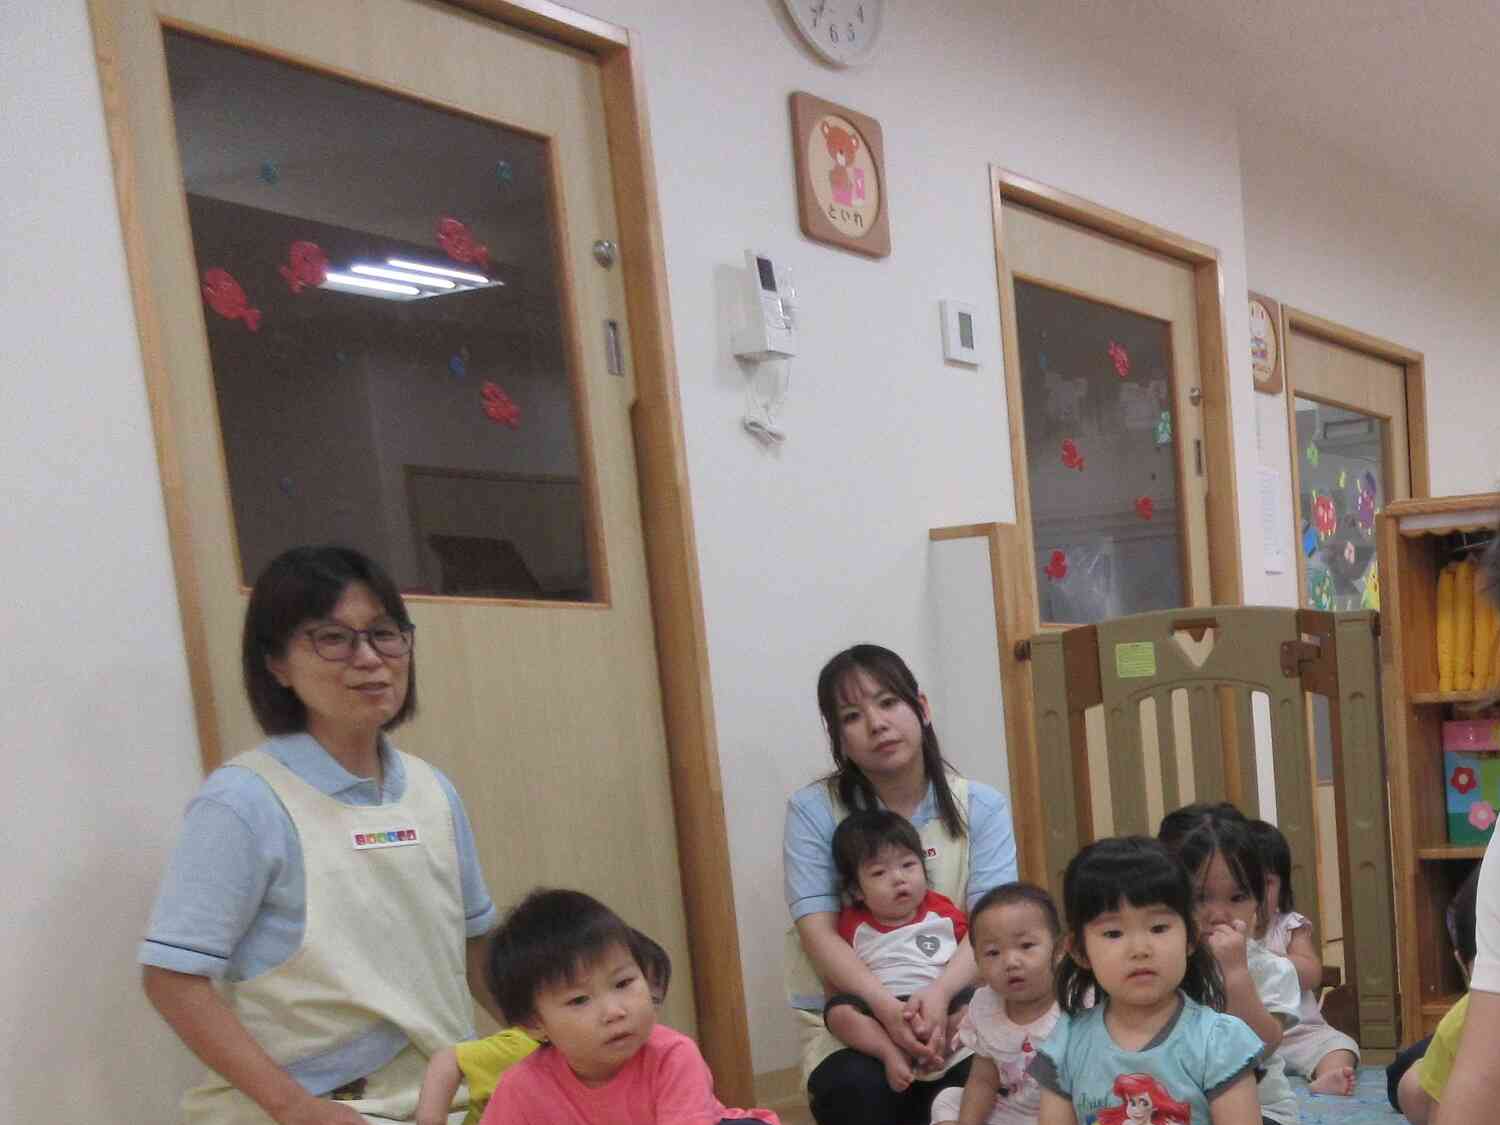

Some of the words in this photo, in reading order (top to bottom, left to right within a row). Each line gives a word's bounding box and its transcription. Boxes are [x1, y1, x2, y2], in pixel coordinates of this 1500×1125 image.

[829, 23, 840, 43] 6
[828, 203, 864, 228] といれ
